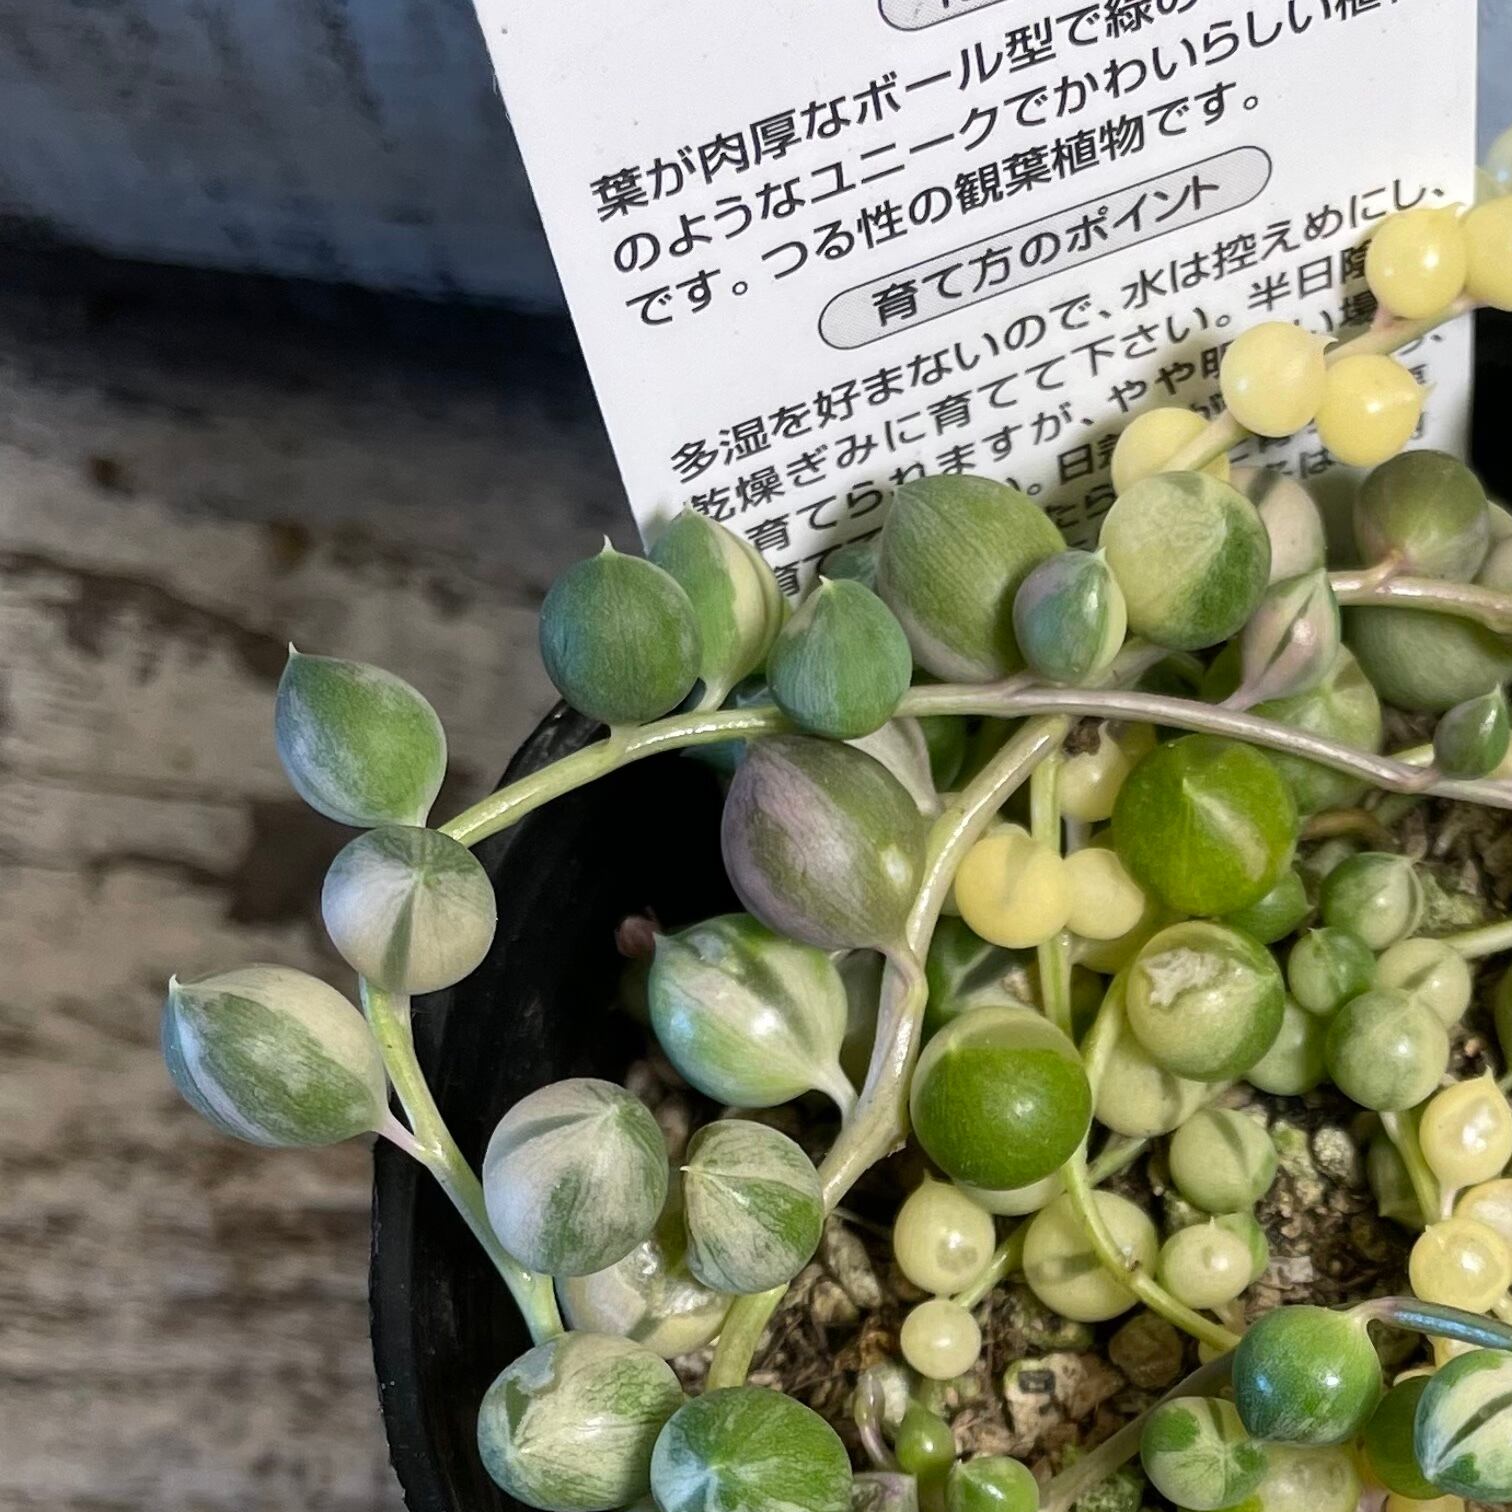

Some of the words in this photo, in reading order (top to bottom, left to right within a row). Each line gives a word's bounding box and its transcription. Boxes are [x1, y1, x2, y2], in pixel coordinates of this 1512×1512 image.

[613, 0, 1398, 273] のようなユニークでかわいらしい
[625, 82, 1259, 326] です。つる性の観葉植物です。
[872, 175, 1219, 327] 育て方のポイント
[671, 179, 1445, 484] 多湿を好まないので、水は控えめにし、
